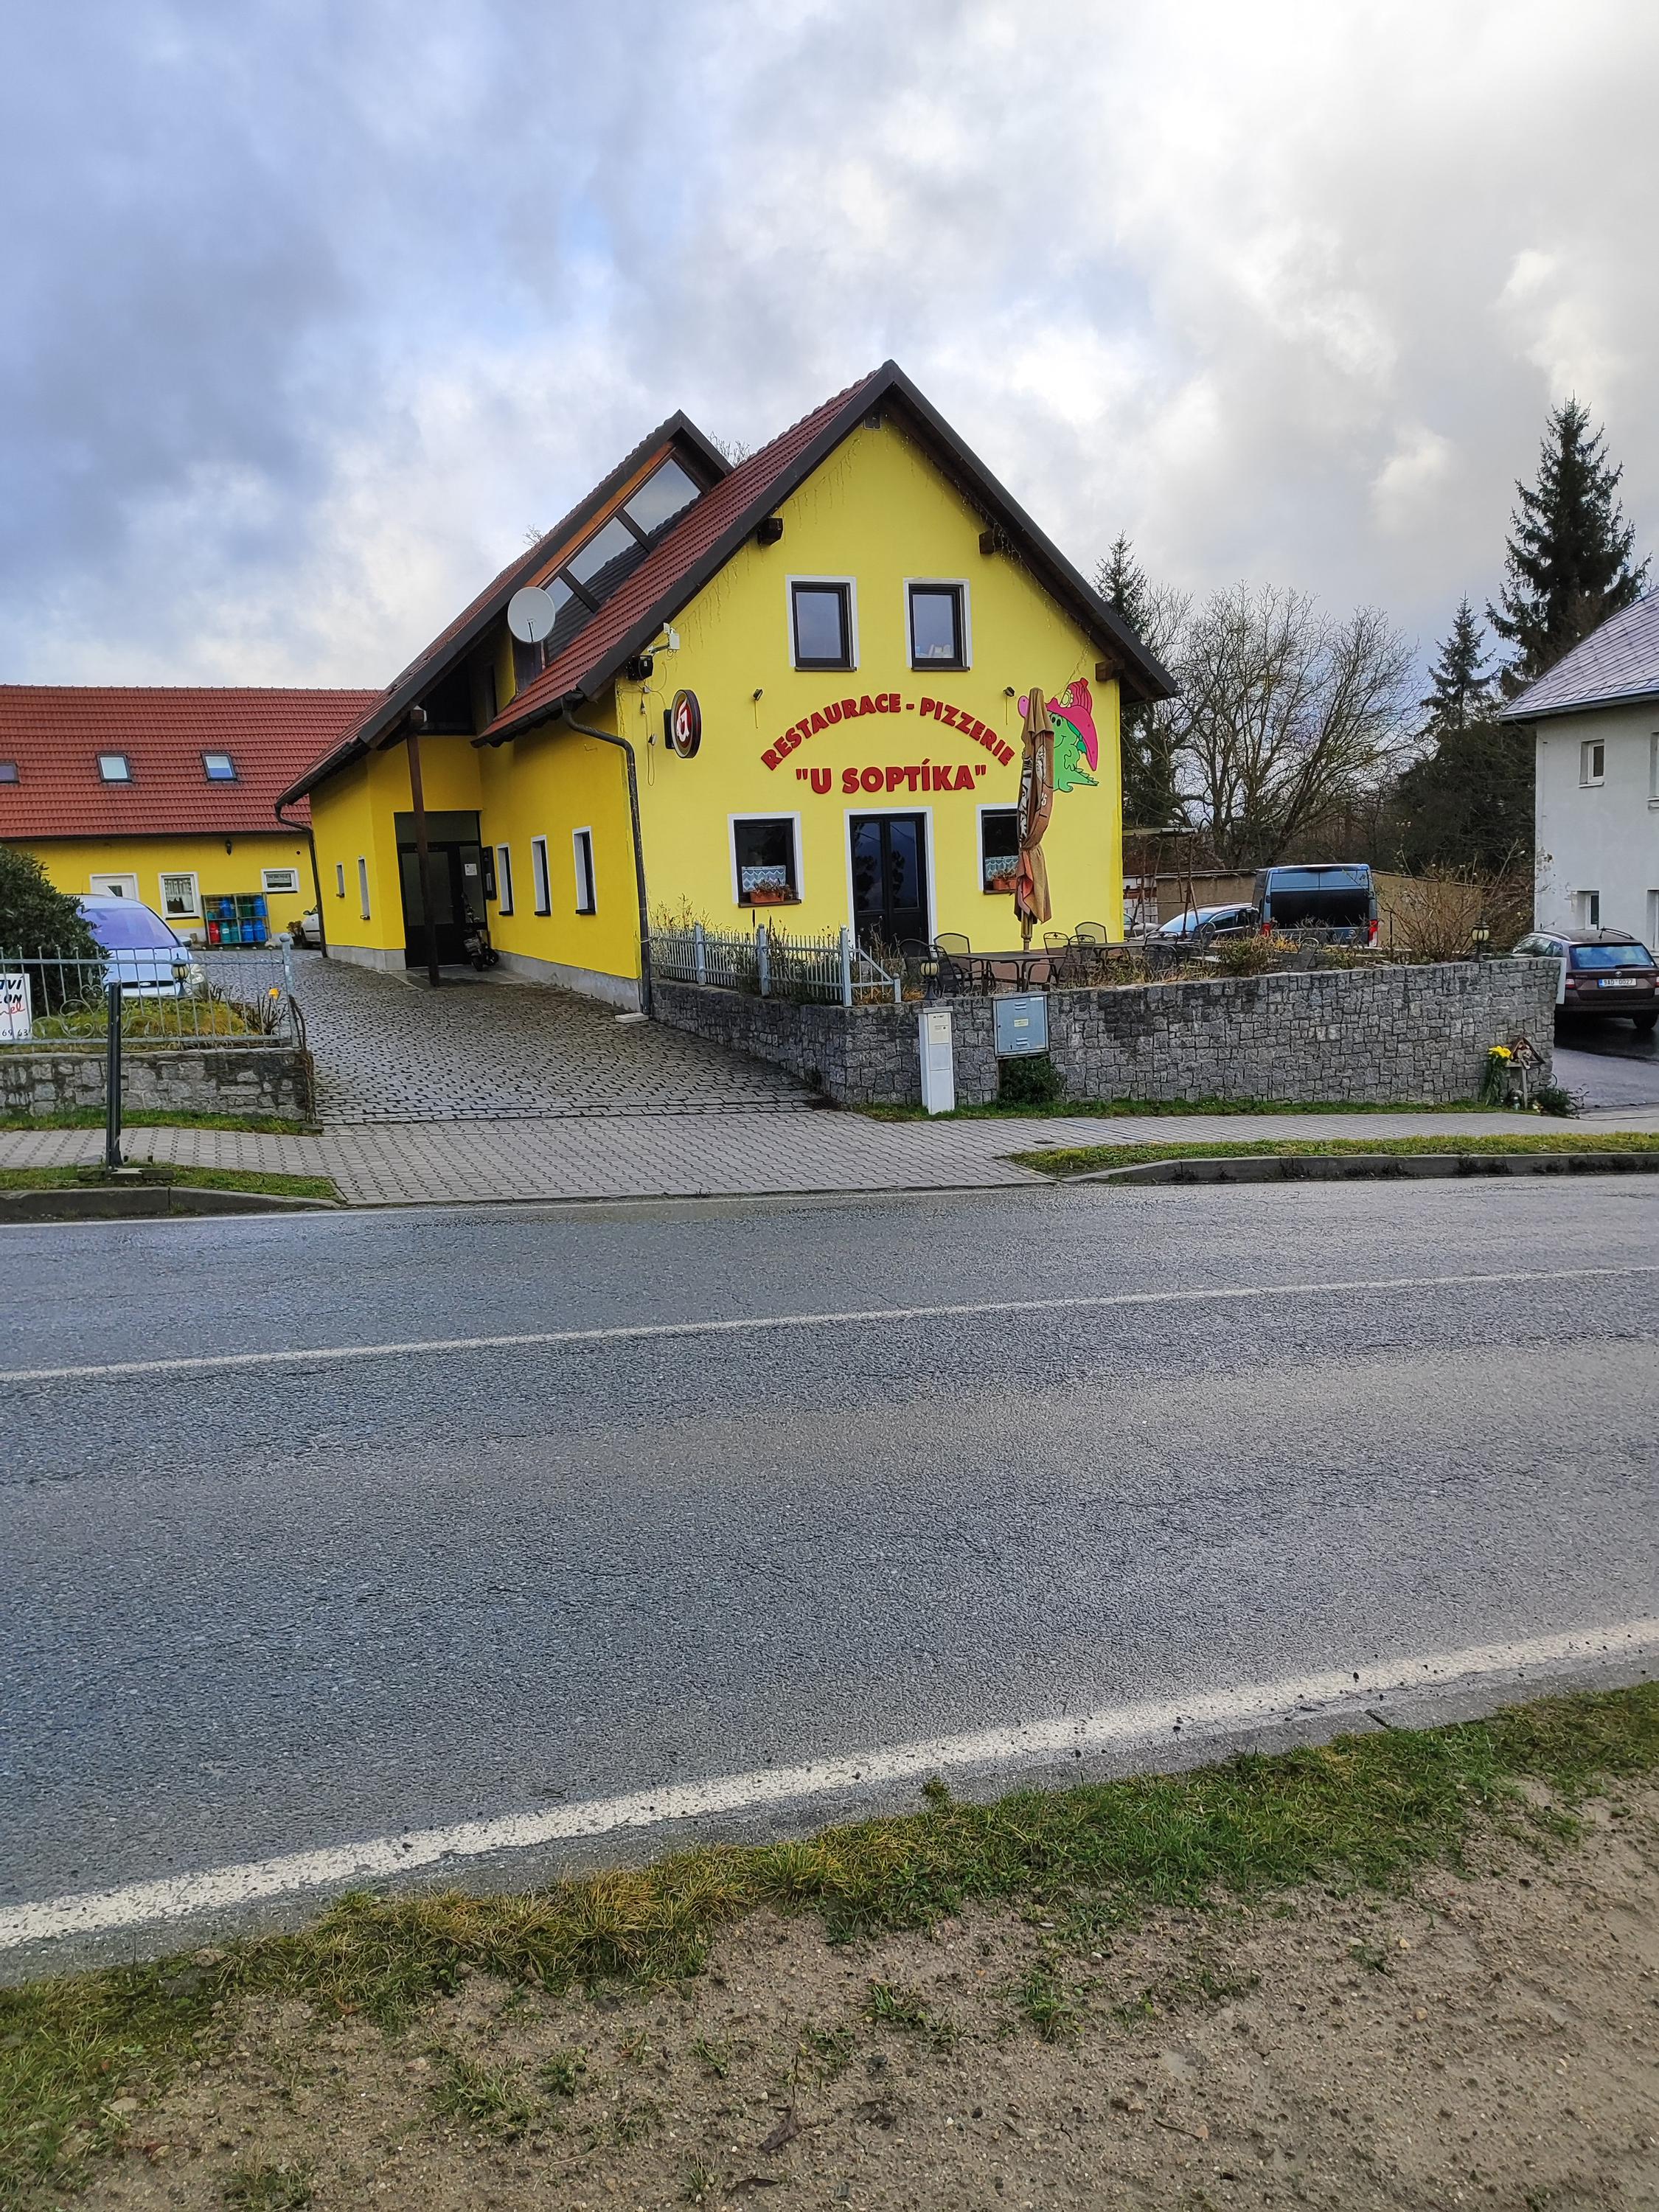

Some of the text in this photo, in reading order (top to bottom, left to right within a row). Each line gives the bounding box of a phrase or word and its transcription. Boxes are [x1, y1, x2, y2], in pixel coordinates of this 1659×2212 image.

[760, 693, 901, 771] RESTAURACE
[919, 697, 1015, 767] PIZZERIE
[796, 758, 987, 794] "U SOPTÍKA"
